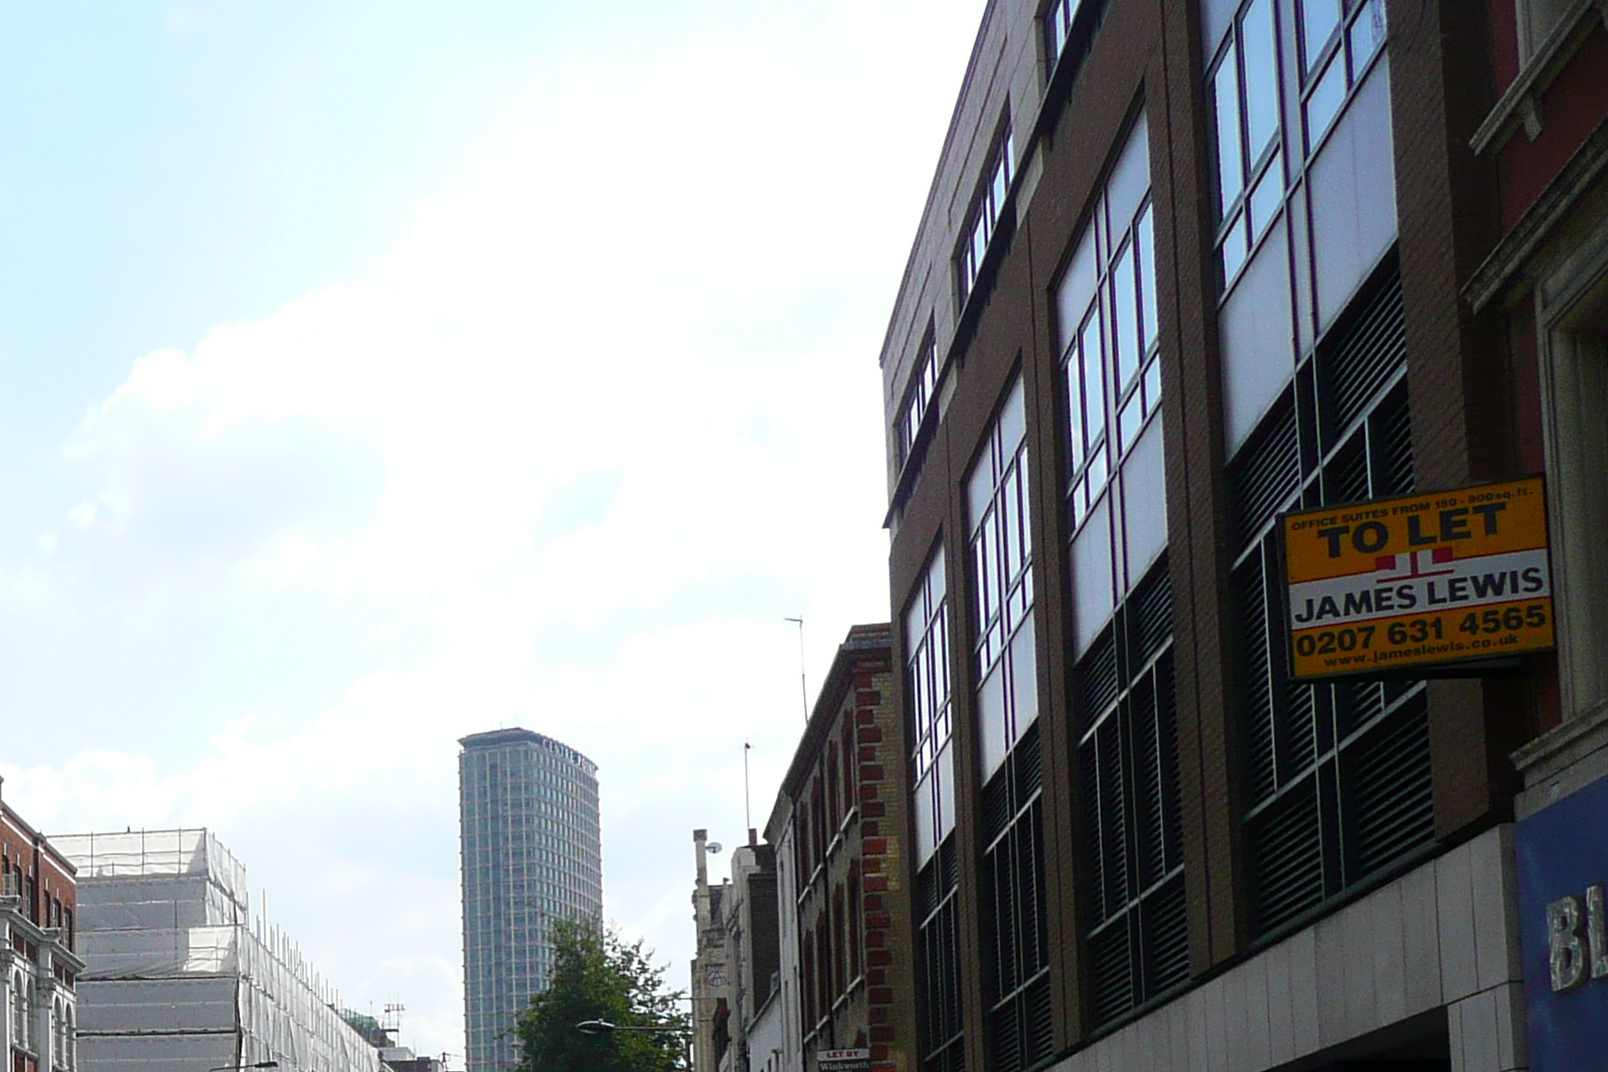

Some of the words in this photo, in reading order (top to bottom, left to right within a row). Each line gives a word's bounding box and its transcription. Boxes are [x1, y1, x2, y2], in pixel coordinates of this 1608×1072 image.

[1291, 515, 1339, 532] OFFICE
[1341, 508, 1389, 523] SUITES
[1393, 502, 1431, 516] FROM
[1317, 520, 1390, 559] TO
[1407, 501, 1507, 547] LET
[1294, 584, 1418, 624] JAMES
[1426, 567, 1544, 606] LEWIS
[1295, 625, 1377, 658] 0207
[1387, 616, 1444, 646] 631
[1458, 604, 1547, 636] 4565
[1323, 633, 1519, 667] www.jameslewis.co.uk
[819, 1061, 869, 1072] Winkworth
[826, 1051, 844, 1059] LET
[846, 1050, 859, 1058] BY
